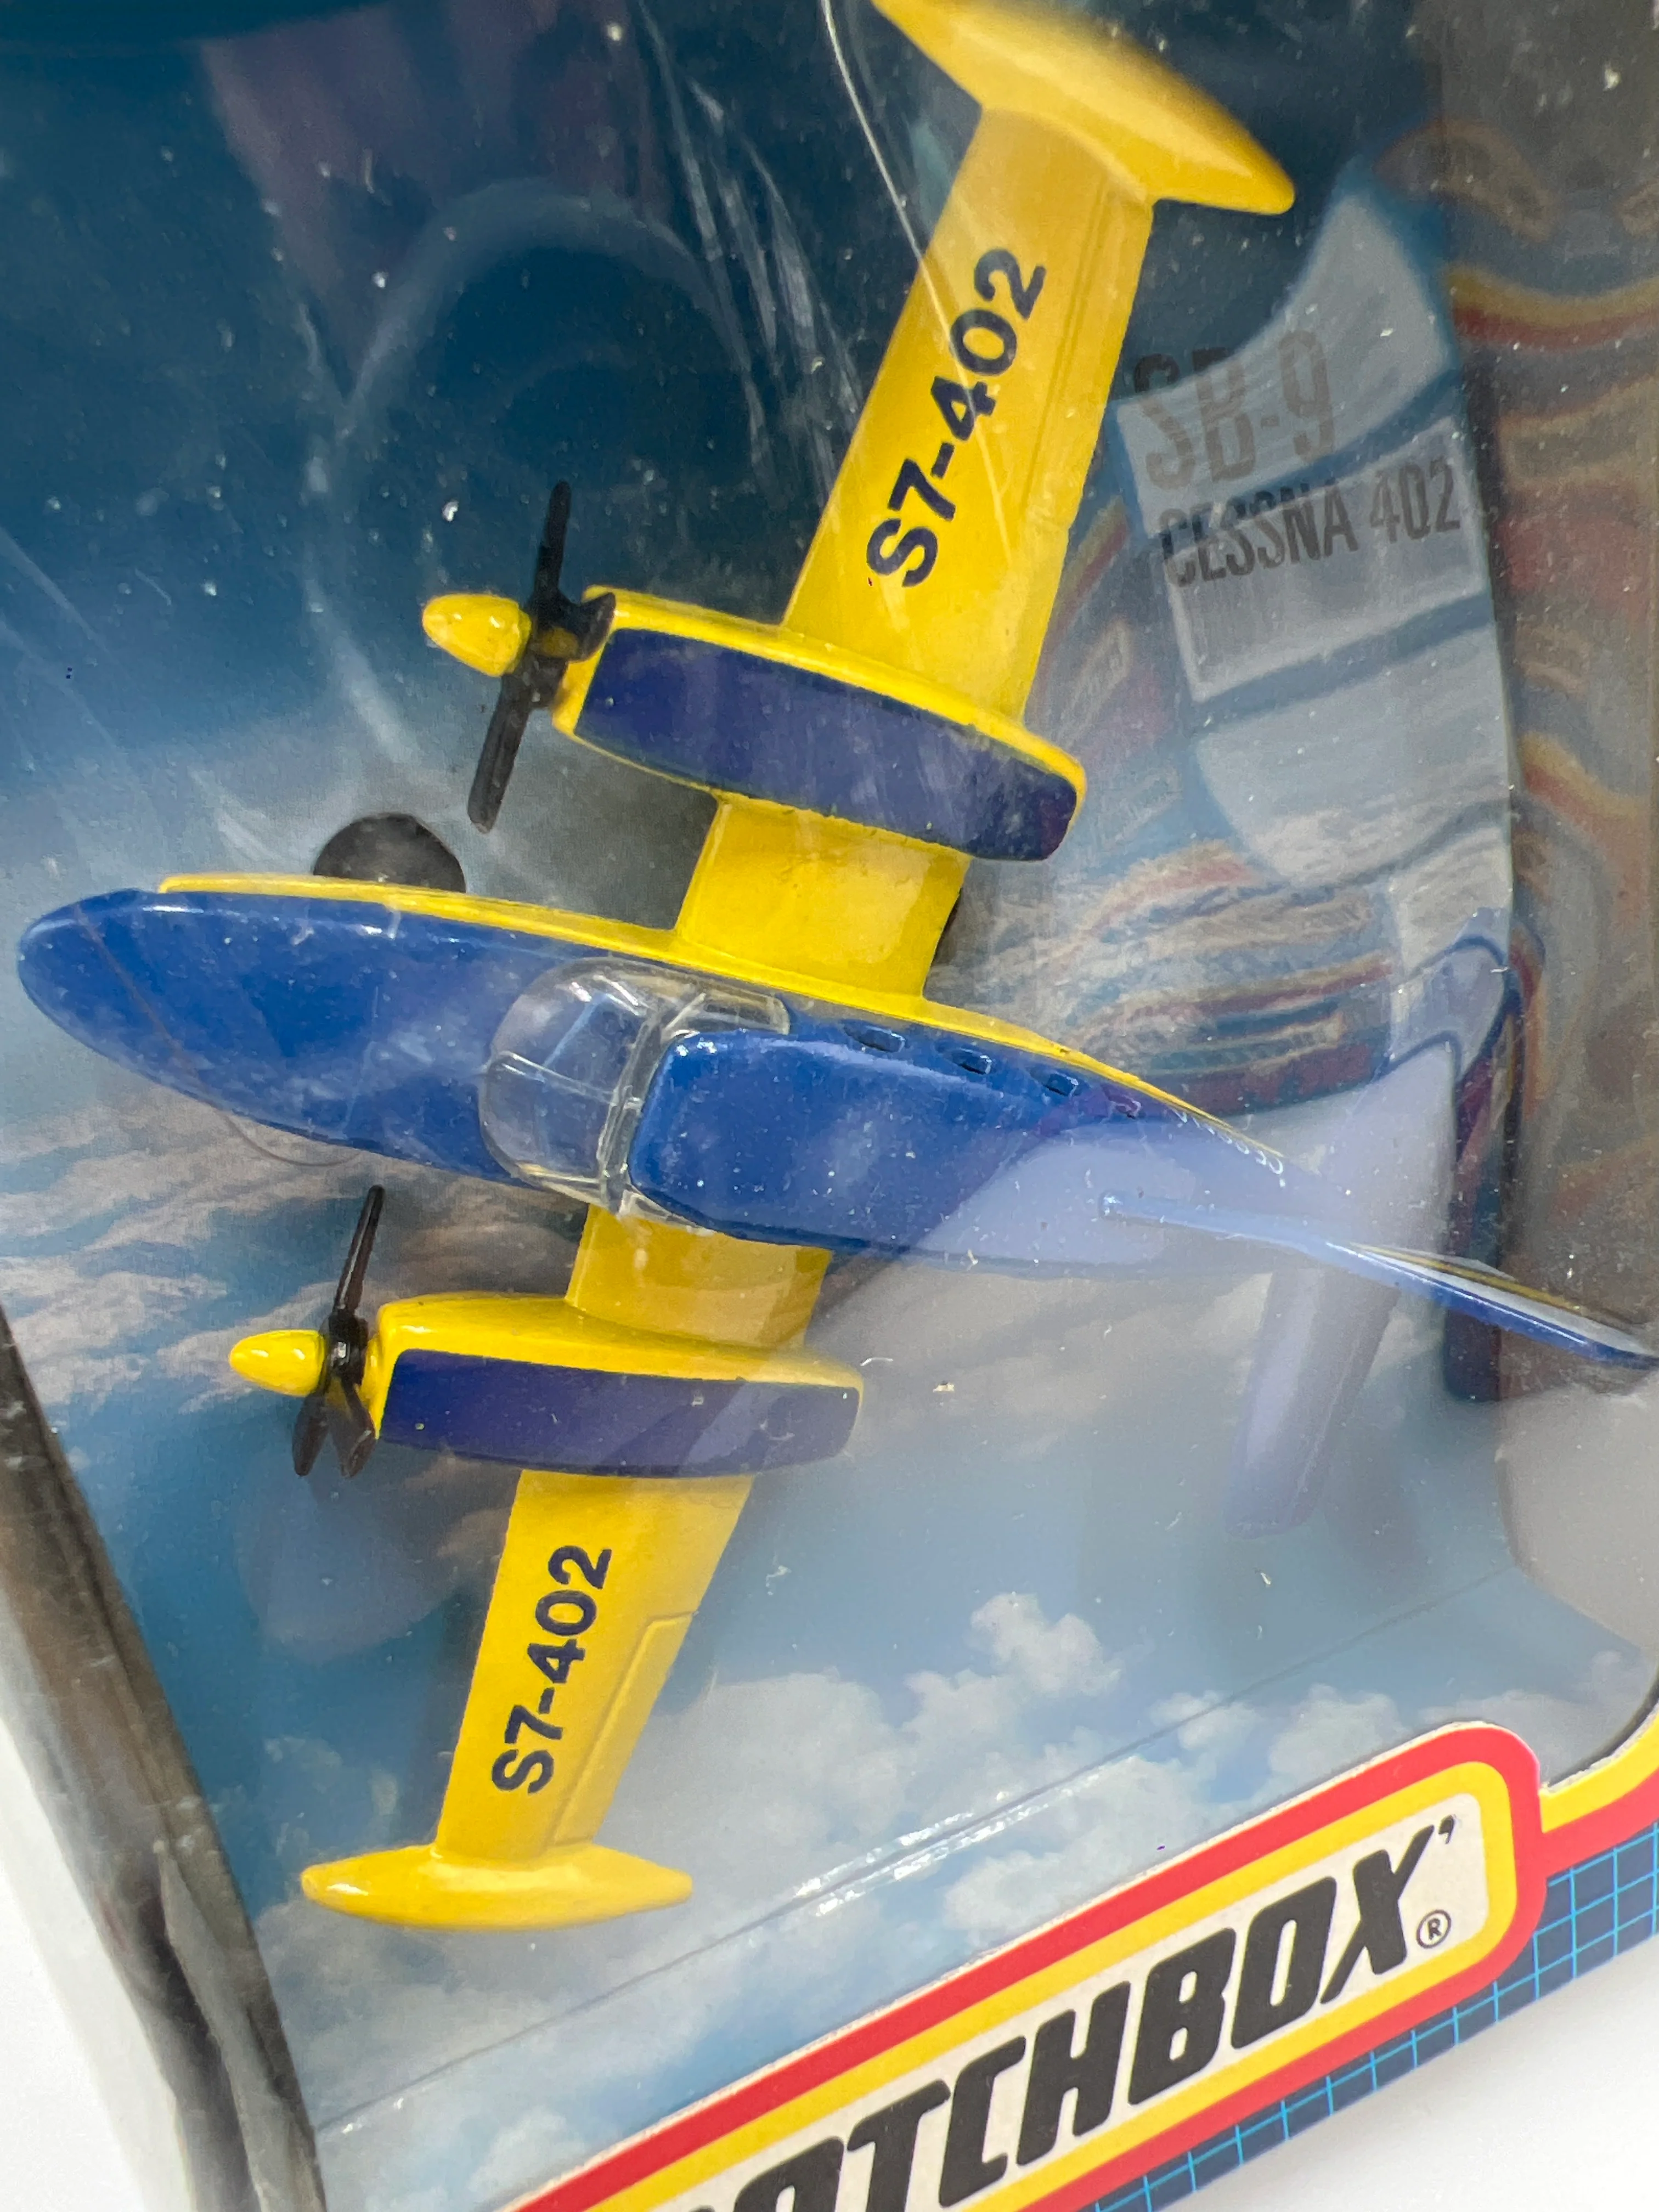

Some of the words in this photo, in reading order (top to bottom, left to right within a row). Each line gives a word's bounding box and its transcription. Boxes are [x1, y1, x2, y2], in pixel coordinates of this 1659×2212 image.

[866, 248, 1046, 588] S7-402
[1133, 330, 1335, 492] SB-9
[1159, 476, 1359, 588] CESSNA
[1369, 456, 1462, 544] 402
[492, 1545, 613, 1794] S7-402
